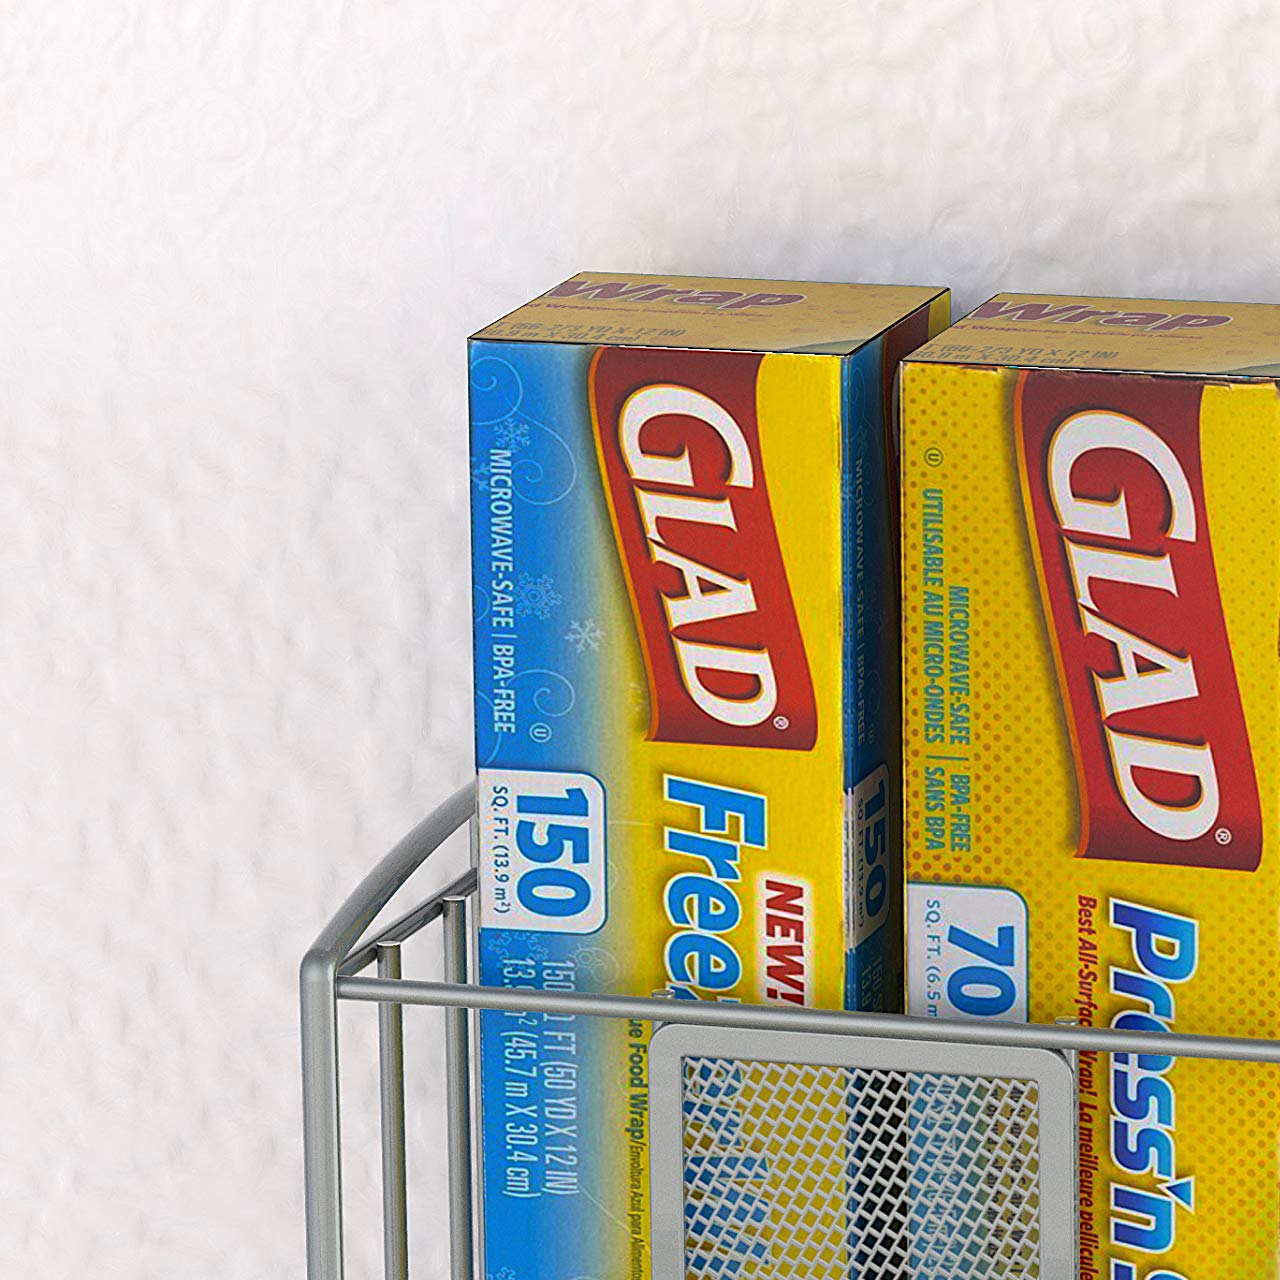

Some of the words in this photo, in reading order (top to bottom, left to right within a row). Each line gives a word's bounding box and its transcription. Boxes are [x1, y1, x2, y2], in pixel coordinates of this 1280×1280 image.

[549, 280, 805, 309] Wrap
[968, 301, 1233, 332] Wrap
[490, 449, 514, 628] MICROWAVE-SAFE
[619, 383, 778, 727] GLAD
[922, 488, 944, 588] UTILISABLE
[923, 591, 944, 617] AU
[1048, 409, 1219, 840] GLAD
[923, 621, 945, 744] MICRO-ONDES
[949, 586, 970, 746] MICROWAVE-SAFE
[492, 643, 516, 734] BPA-FREE
[491, 786, 508, 812] SQ.
[925, 767, 945, 812] SANS
[494, 817, 508, 839] FT.
[951, 775, 971, 853] BPA-FREE
[864, 779, 886, 917] 150
[925, 818, 946, 850] BPA
[492, 845, 510, 884] (13.9
[516, 788, 591, 917] 150
[925, 899, 941, 928] SQ.
[1078, 894, 1098, 935] Best
[765, 880, 806, 1006] NEW!
[927, 935, 941, 959] FT.
[542, 959, 575, 992] 150
[926, 966, 941, 1000] (6.5
[947, 925, 1016, 1016] 70
[1075, 937, 1098, 1032] All-Surfac
[543, 1031, 576, 1054] FT
[628, 1018, 644, 1038] ue
[500, 1031, 539, 1077] (45.7
[629, 1043, 648, 1087] Food
[505, 1081, 529, 1097] m
[540, 1061, 578, 1089] (50
[505, 1103, 538, 1118] X
[544, 1097, 577, 1120] YD
[1079, 1101, 1098, 1124] La
[505, 1123, 538, 1162] 30.4
[545, 1124, 578, 1137] X
[545, 1144, 578, 1165] 12
[1079, 1126, 1099, 1207] meilleure
[502, 1167, 541, 1198] cm)
[541, 1170, 580, 1195] IN)
